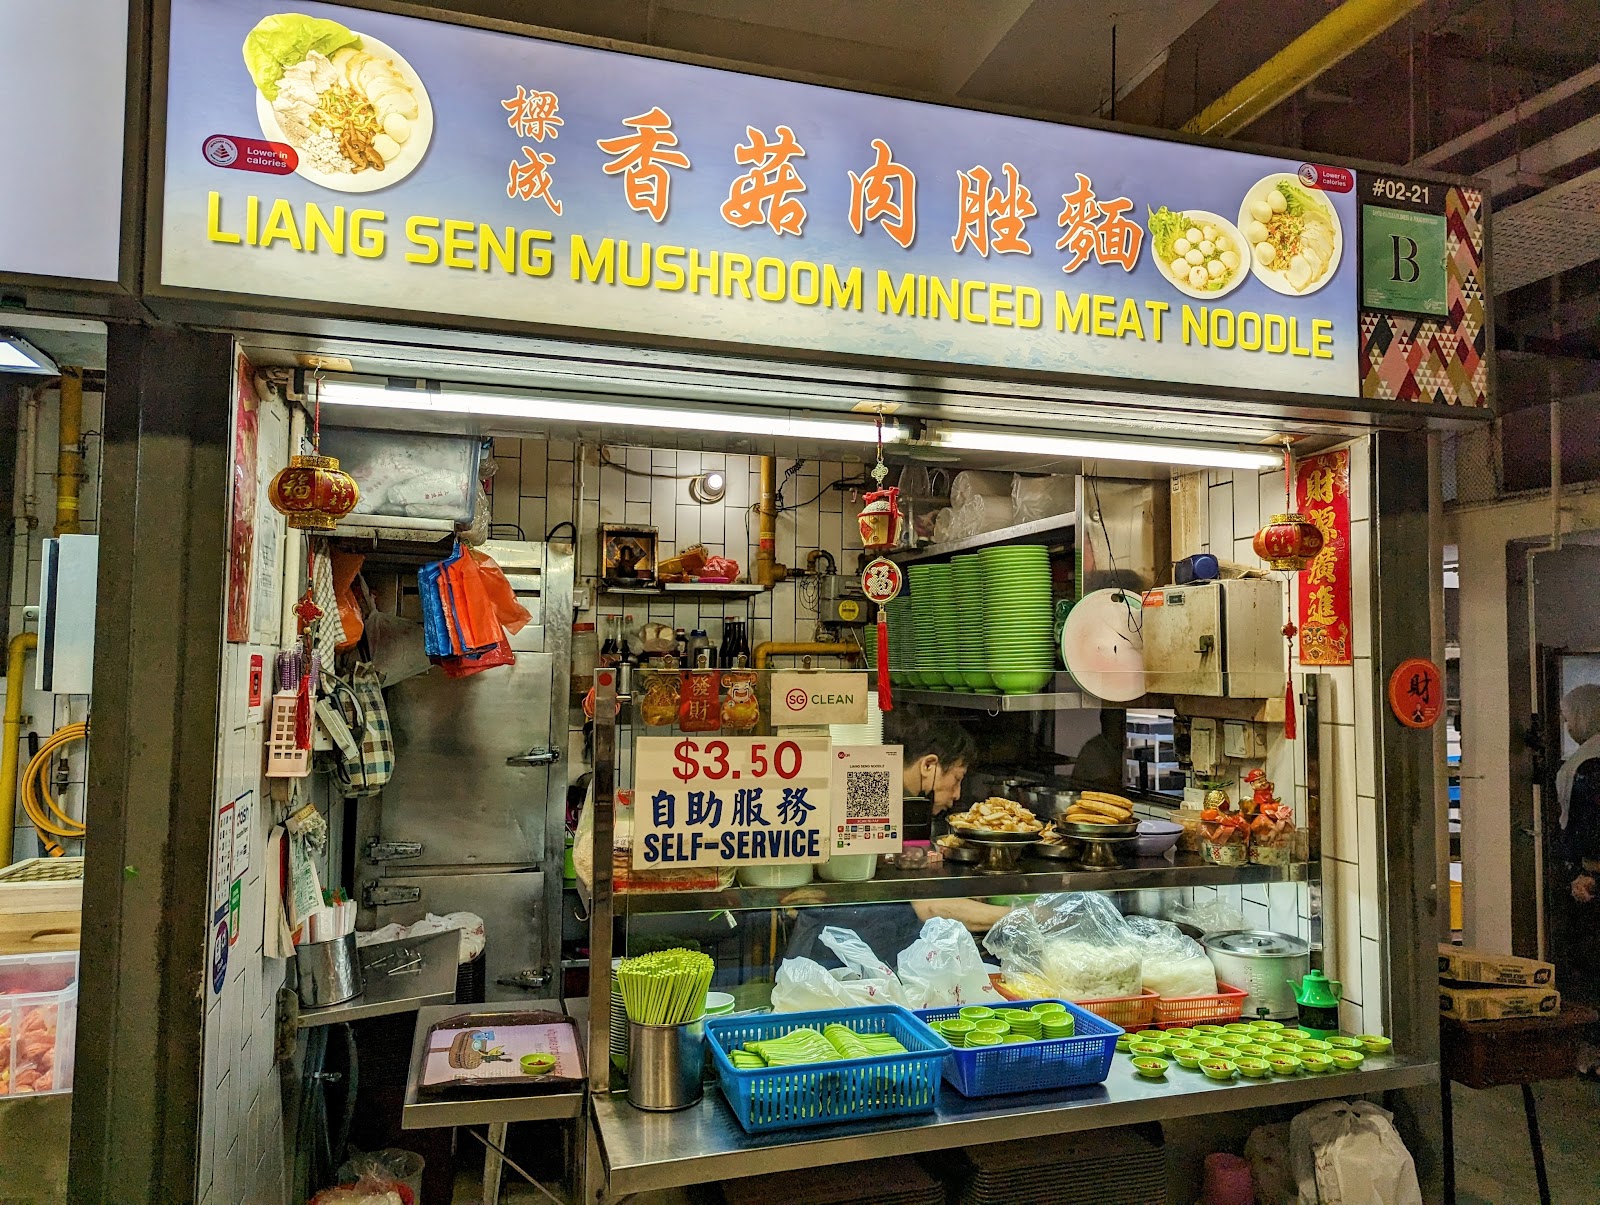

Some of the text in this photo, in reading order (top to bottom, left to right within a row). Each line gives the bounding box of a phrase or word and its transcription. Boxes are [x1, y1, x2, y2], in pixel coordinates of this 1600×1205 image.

[246, 156, 287, 168] calories
[247, 146, 288, 160] Lower in
[1322, 171, 1340, 180] Lower
[1322, 178, 1347, 188] calories
[1372, 178, 1430, 205] #02-21
[207, 190, 1333, 359] LIANG SENG MUSHROOM MINCED MEAT NOODLE
[1388, 233, 1420, 284] B
[689, 674, 711, 722] 發財
[811, 694, 854, 705] CLEAN
[1407, 669, 1433, 705] 財
[672, 737, 803, 784] $3.50
[651, 787, 817, 829] 自助服務
[643, 829, 820, 863] SELF-SERVICE
